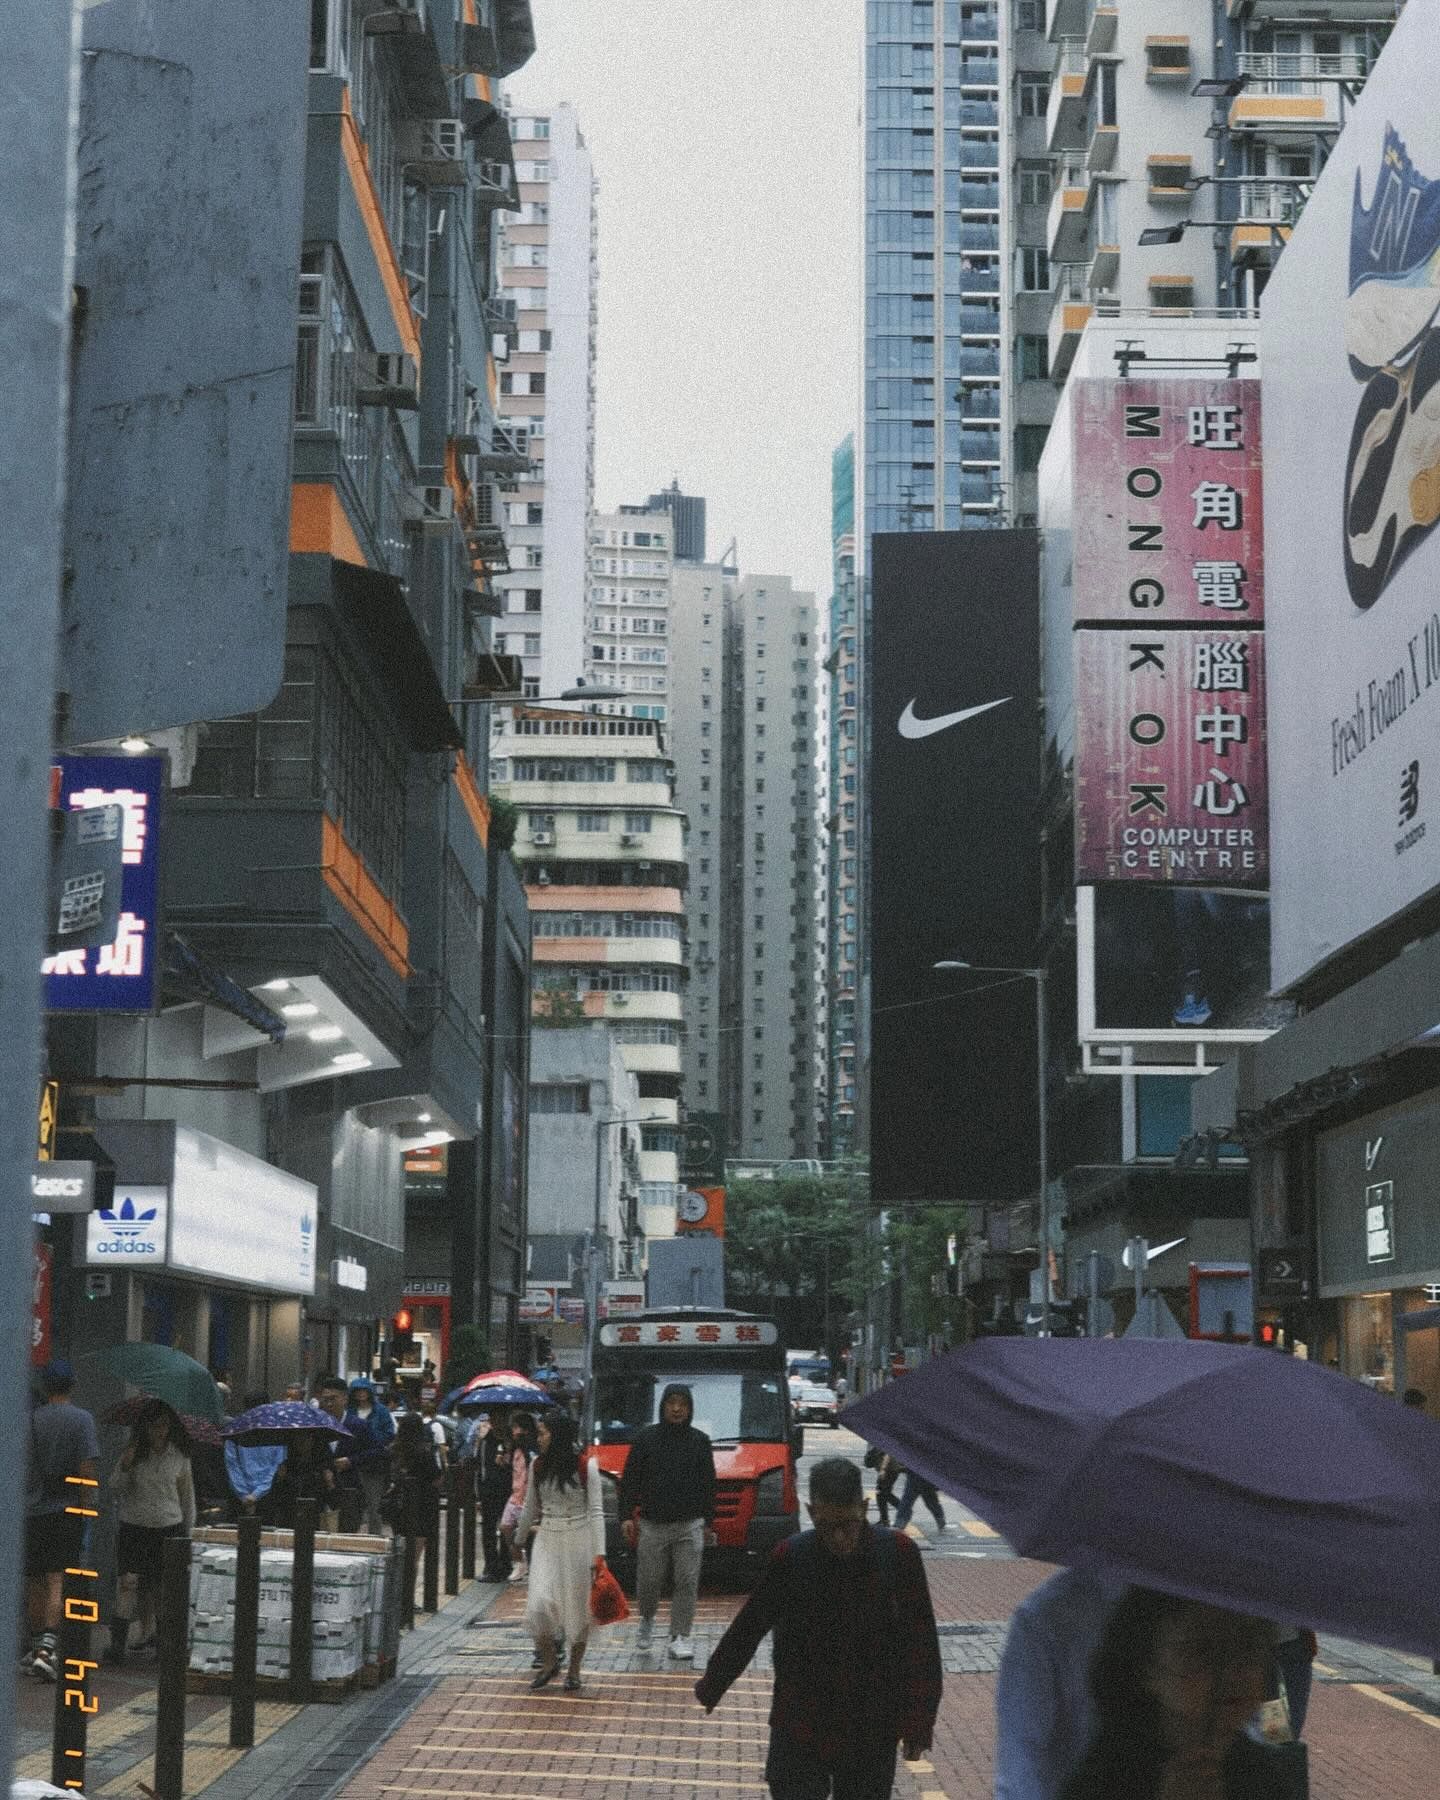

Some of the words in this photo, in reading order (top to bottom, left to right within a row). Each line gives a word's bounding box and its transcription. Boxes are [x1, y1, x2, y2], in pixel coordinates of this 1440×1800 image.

[1187, 404, 1250, 817] 旺角電腦中心
[1331, 690, 1367, 777] Fresh
[1368, 667, 1407, 742] Foam
[1408, 634, 1421, 705] X
[1122, 827, 1255, 847] COMPUTER
[1122, 850, 1256, 868] CENTRE
[97, 1239, 156, 1253] adidas
